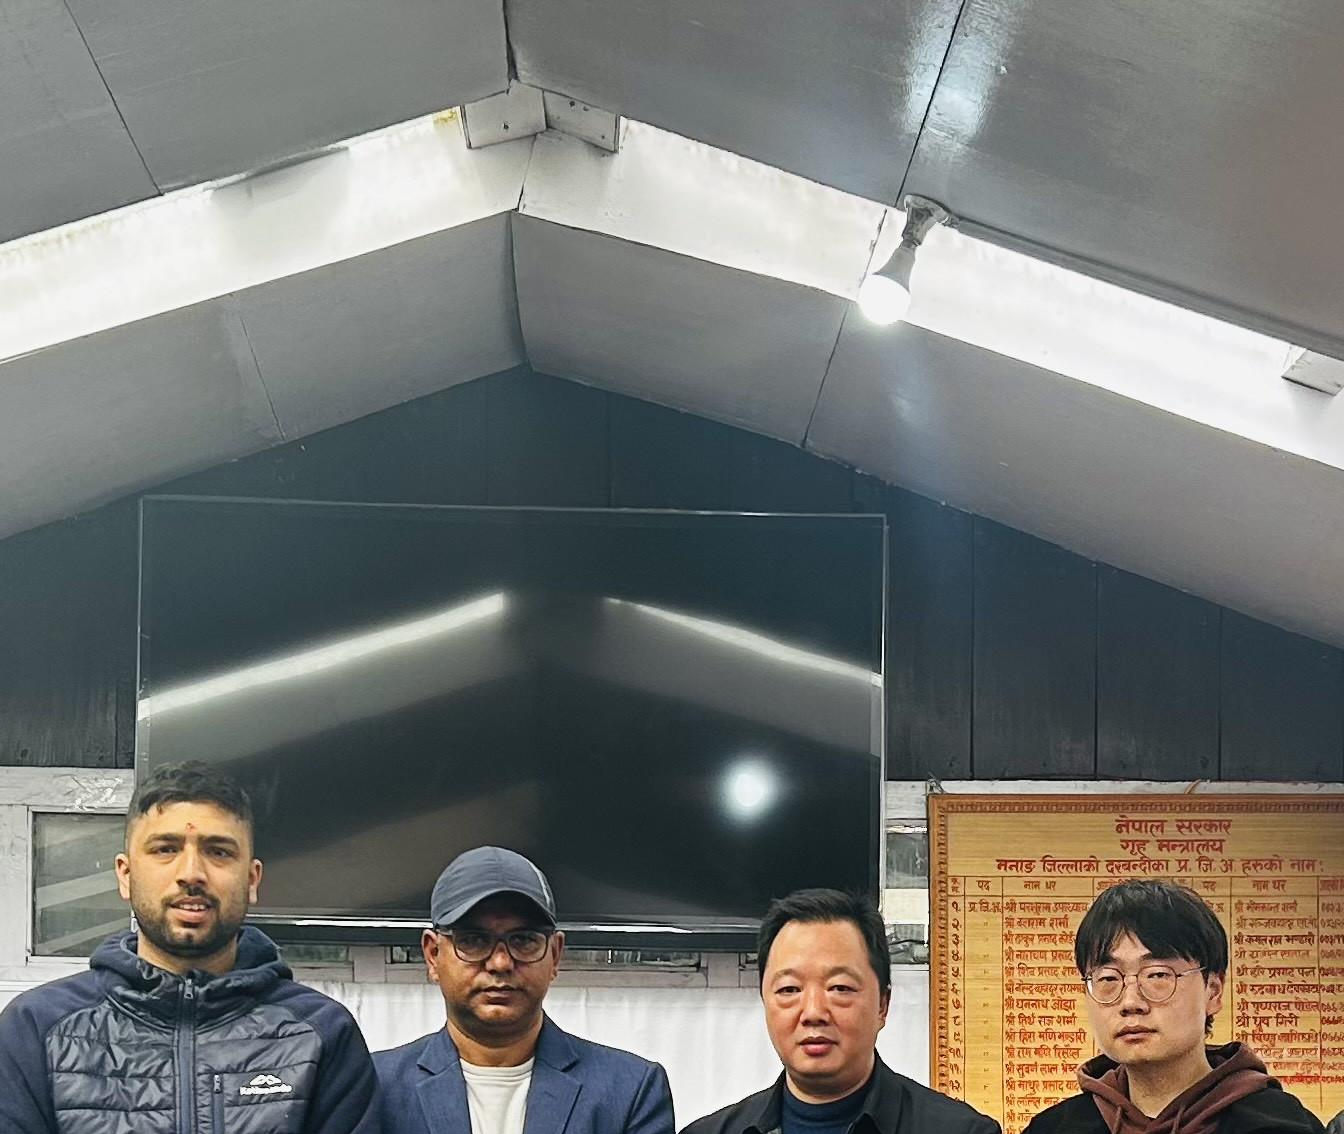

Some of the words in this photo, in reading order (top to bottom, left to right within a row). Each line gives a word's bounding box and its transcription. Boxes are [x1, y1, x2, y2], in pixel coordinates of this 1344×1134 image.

[1115, 815, 1168, 835] नेपाल
[1175, 818, 1233, 835] सरकार
[1120, 839, 1150, 855] गृह
[1157, 838, 1227, 854] मन्त्रालय
[1040, 855, 1100, 874] जिल्लाको
